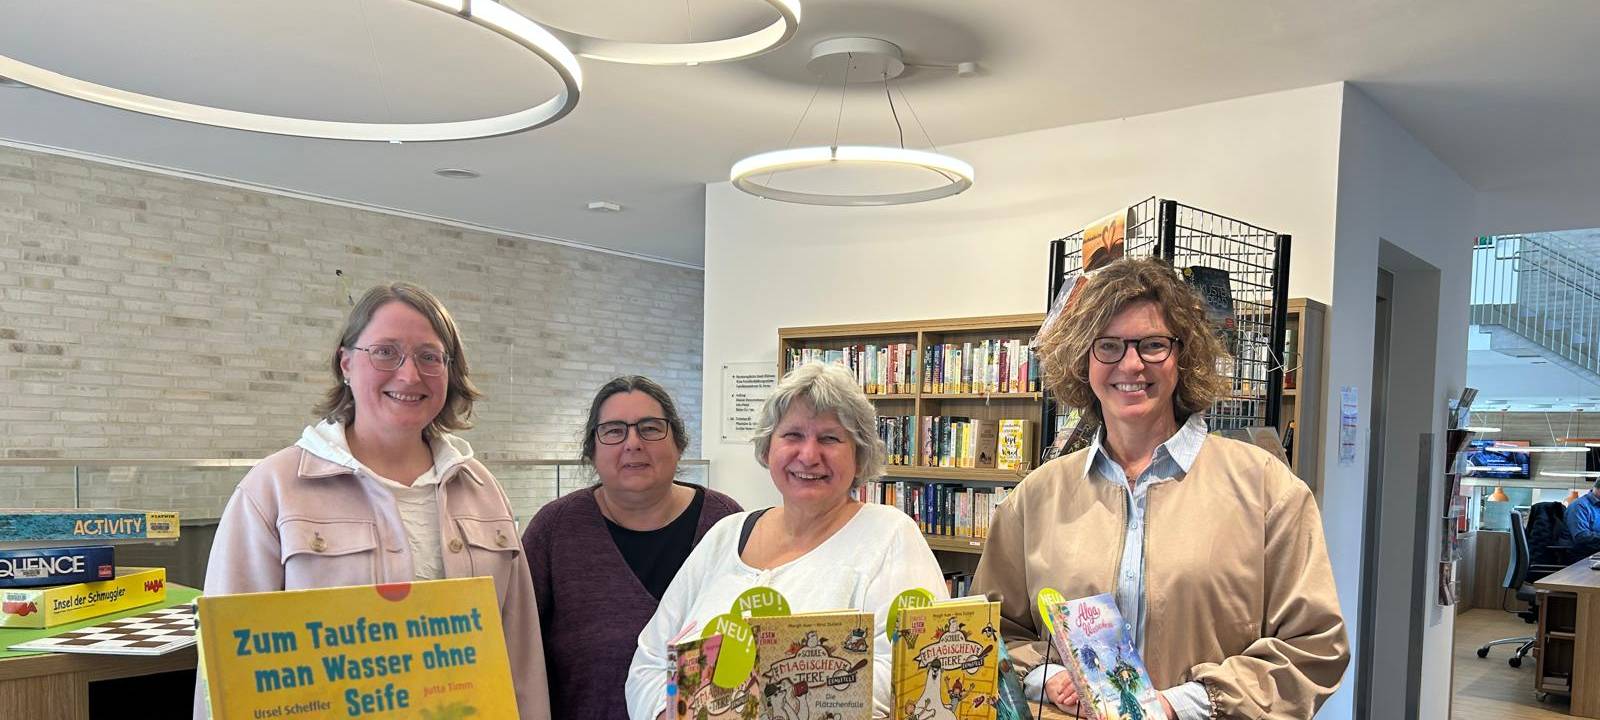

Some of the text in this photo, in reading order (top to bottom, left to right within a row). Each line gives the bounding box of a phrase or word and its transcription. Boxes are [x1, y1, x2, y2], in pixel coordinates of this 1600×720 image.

[73, 517, 142, 535] ACTIVITY
[144, 578, 164, 593] HABA
[53, 595, 73, 610] Insel
[74, 595, 87, 606] der
[87, 586, 126, 603] Schmuggler
[233, 607, 483, 657] Zum Taufen nimmt
[926, 644, 977, 660] MAGISCHEN
[254, 643, 477, 693] man Wasser ohne
[779, 659, 843, 674] MAGISCHEN
[423, 681, 474, 698] Jutta Timm
[344, 683, 410, 717] Seife
[253, 700, 331, 719] Ursel Scheffler
